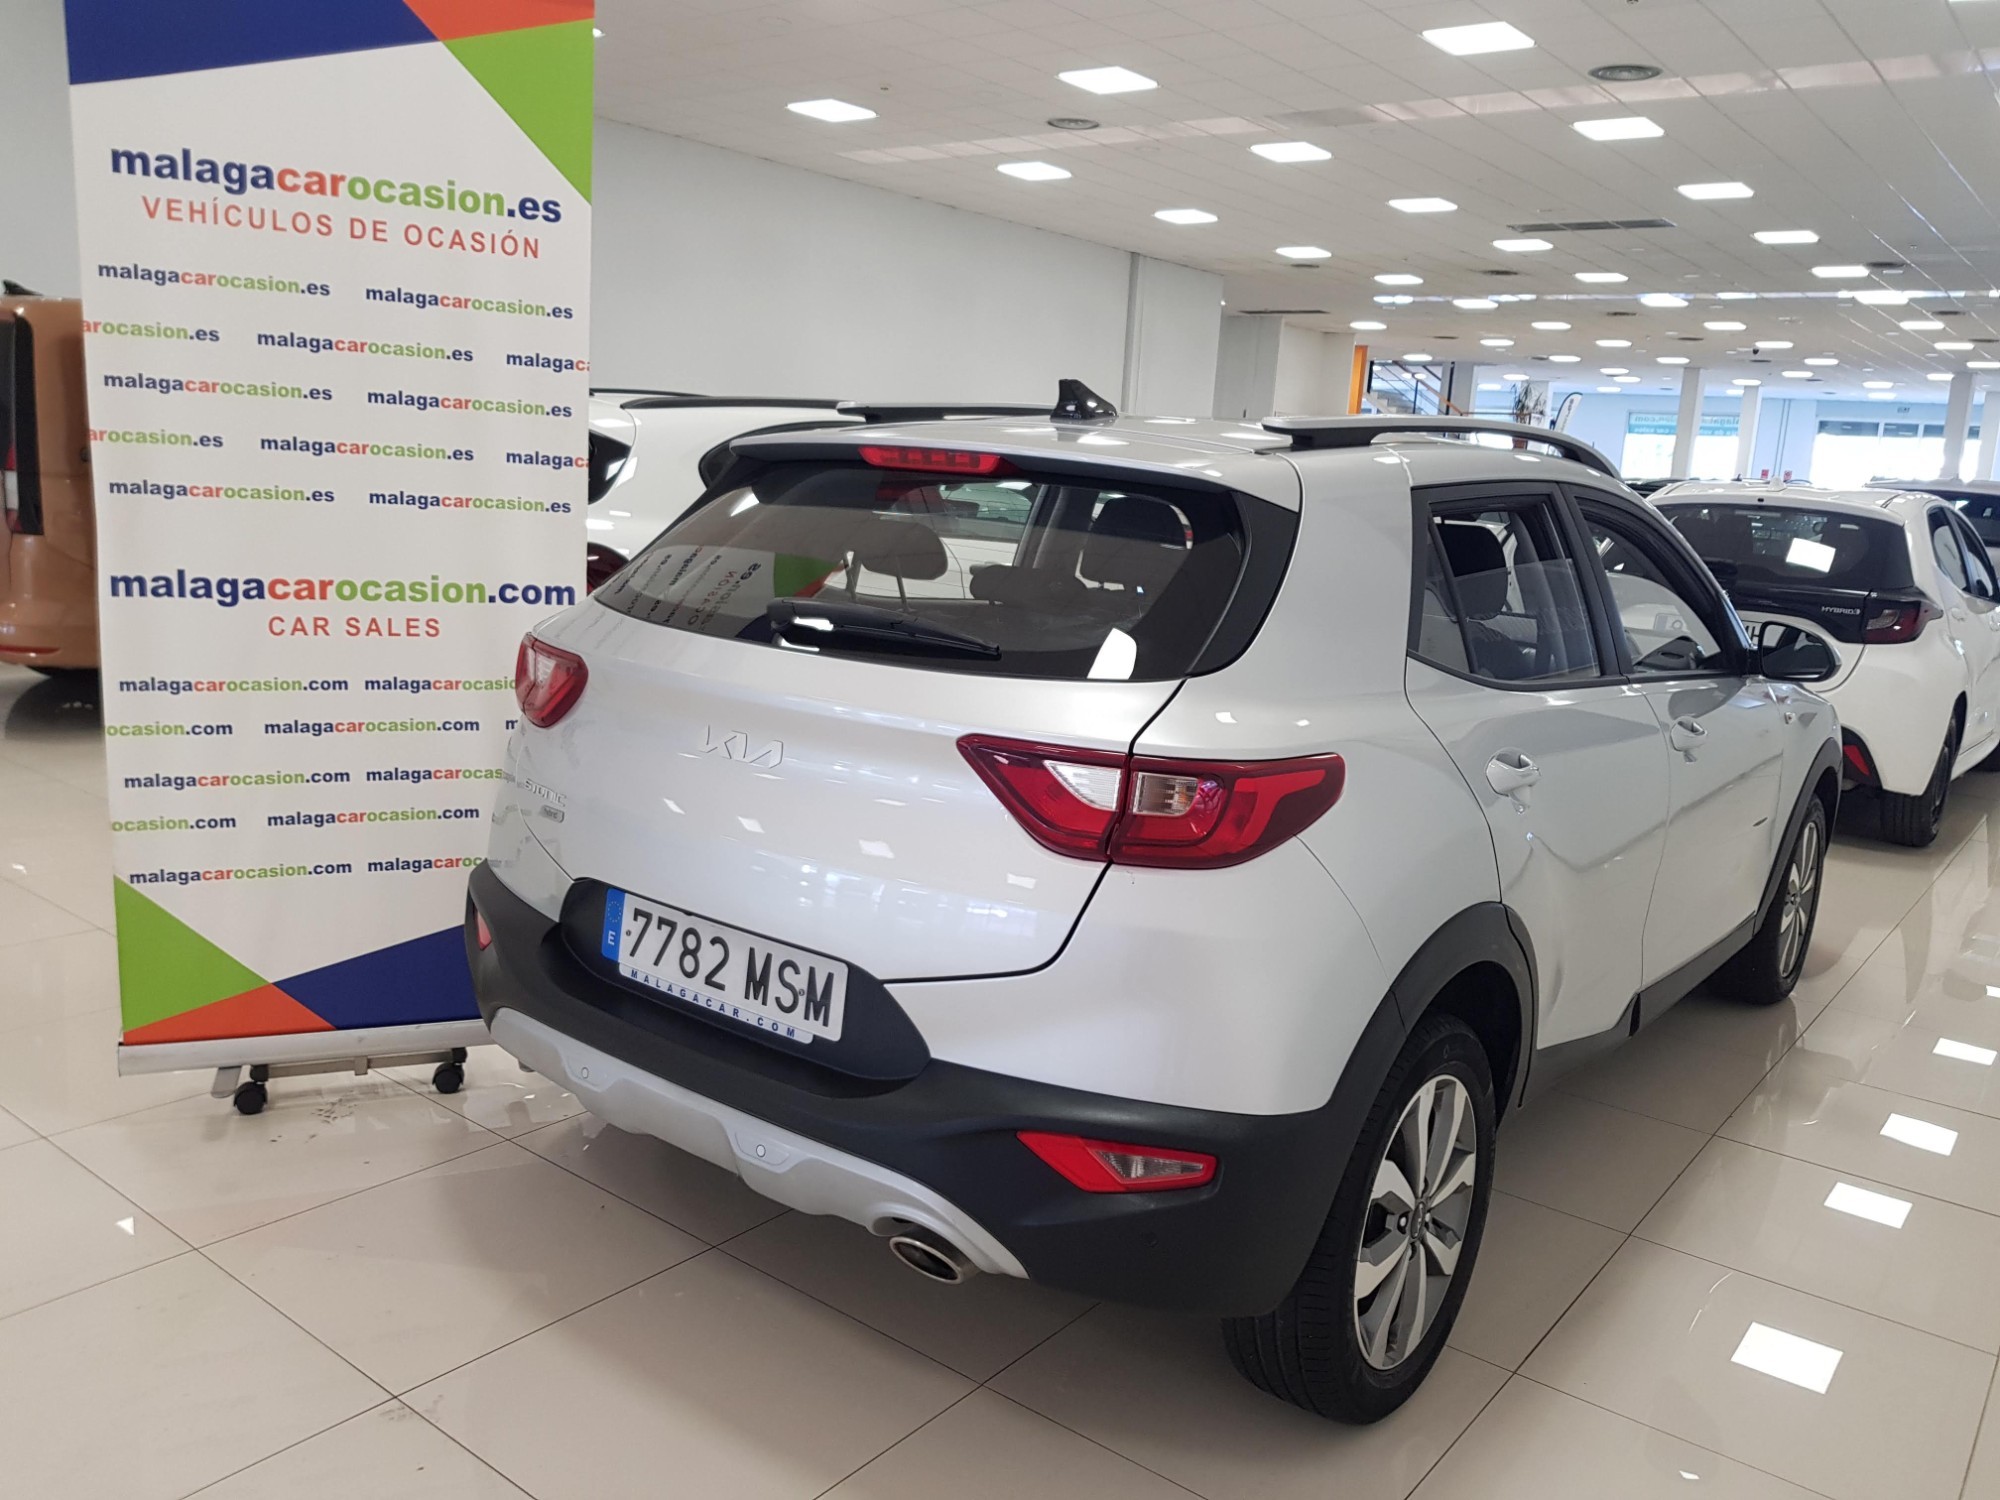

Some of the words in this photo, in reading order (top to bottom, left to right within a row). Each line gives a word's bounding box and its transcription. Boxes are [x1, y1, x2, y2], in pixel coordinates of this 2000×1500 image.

[111, 147, 562, 223] malagacarocasion.es
[143, 195, 335, 236] VEHÍCULOS
[350, 218, 387, 242] DE
[403, 224, 539, 259] OCASIÓN
[98, 264, 330, 296] malagacarocasion.es
[366, 288, 573, 319] malagacarocasion.es
[258, 332, 473, 361] malagacarocasion.es
[104, 373, 332, 400] malagacarocasion.es
[368, 390, 572, 417] malagacarocasion.es
[261, 436, 474, 461] malagacarocasion.es
[507, 447, 589, 470] malagac
[109, 480, 334, 502] malagacarocasion.es
[369, 491, 571, 513] malagacarocasion.es
[110, 569, 575, 605] malagacarocasion.com
[269, 616, 330, 636] CAR
[346, 617, 439, 637] SALES
[120, 677, 348, 695] malagacarocasion.com
[105, 722, 233, 736] ocasion.com
[265, 718, 479, 736] malagacarocasion.com
[125, 771, 350, 790] malagacarocasion.com
[111, 817, 236, 831] ocasion.com
[268, 808, 479, 827] malagacarocasion.com
[129, 863, 352, 885] malagacarocasion.com
[607, 929, 617, 946] E
[629, 907, 730, 992] 7782
[744, 946, 835, 1028] MSM
[630, 968, 796, 1039] MALAGACAR.COM
